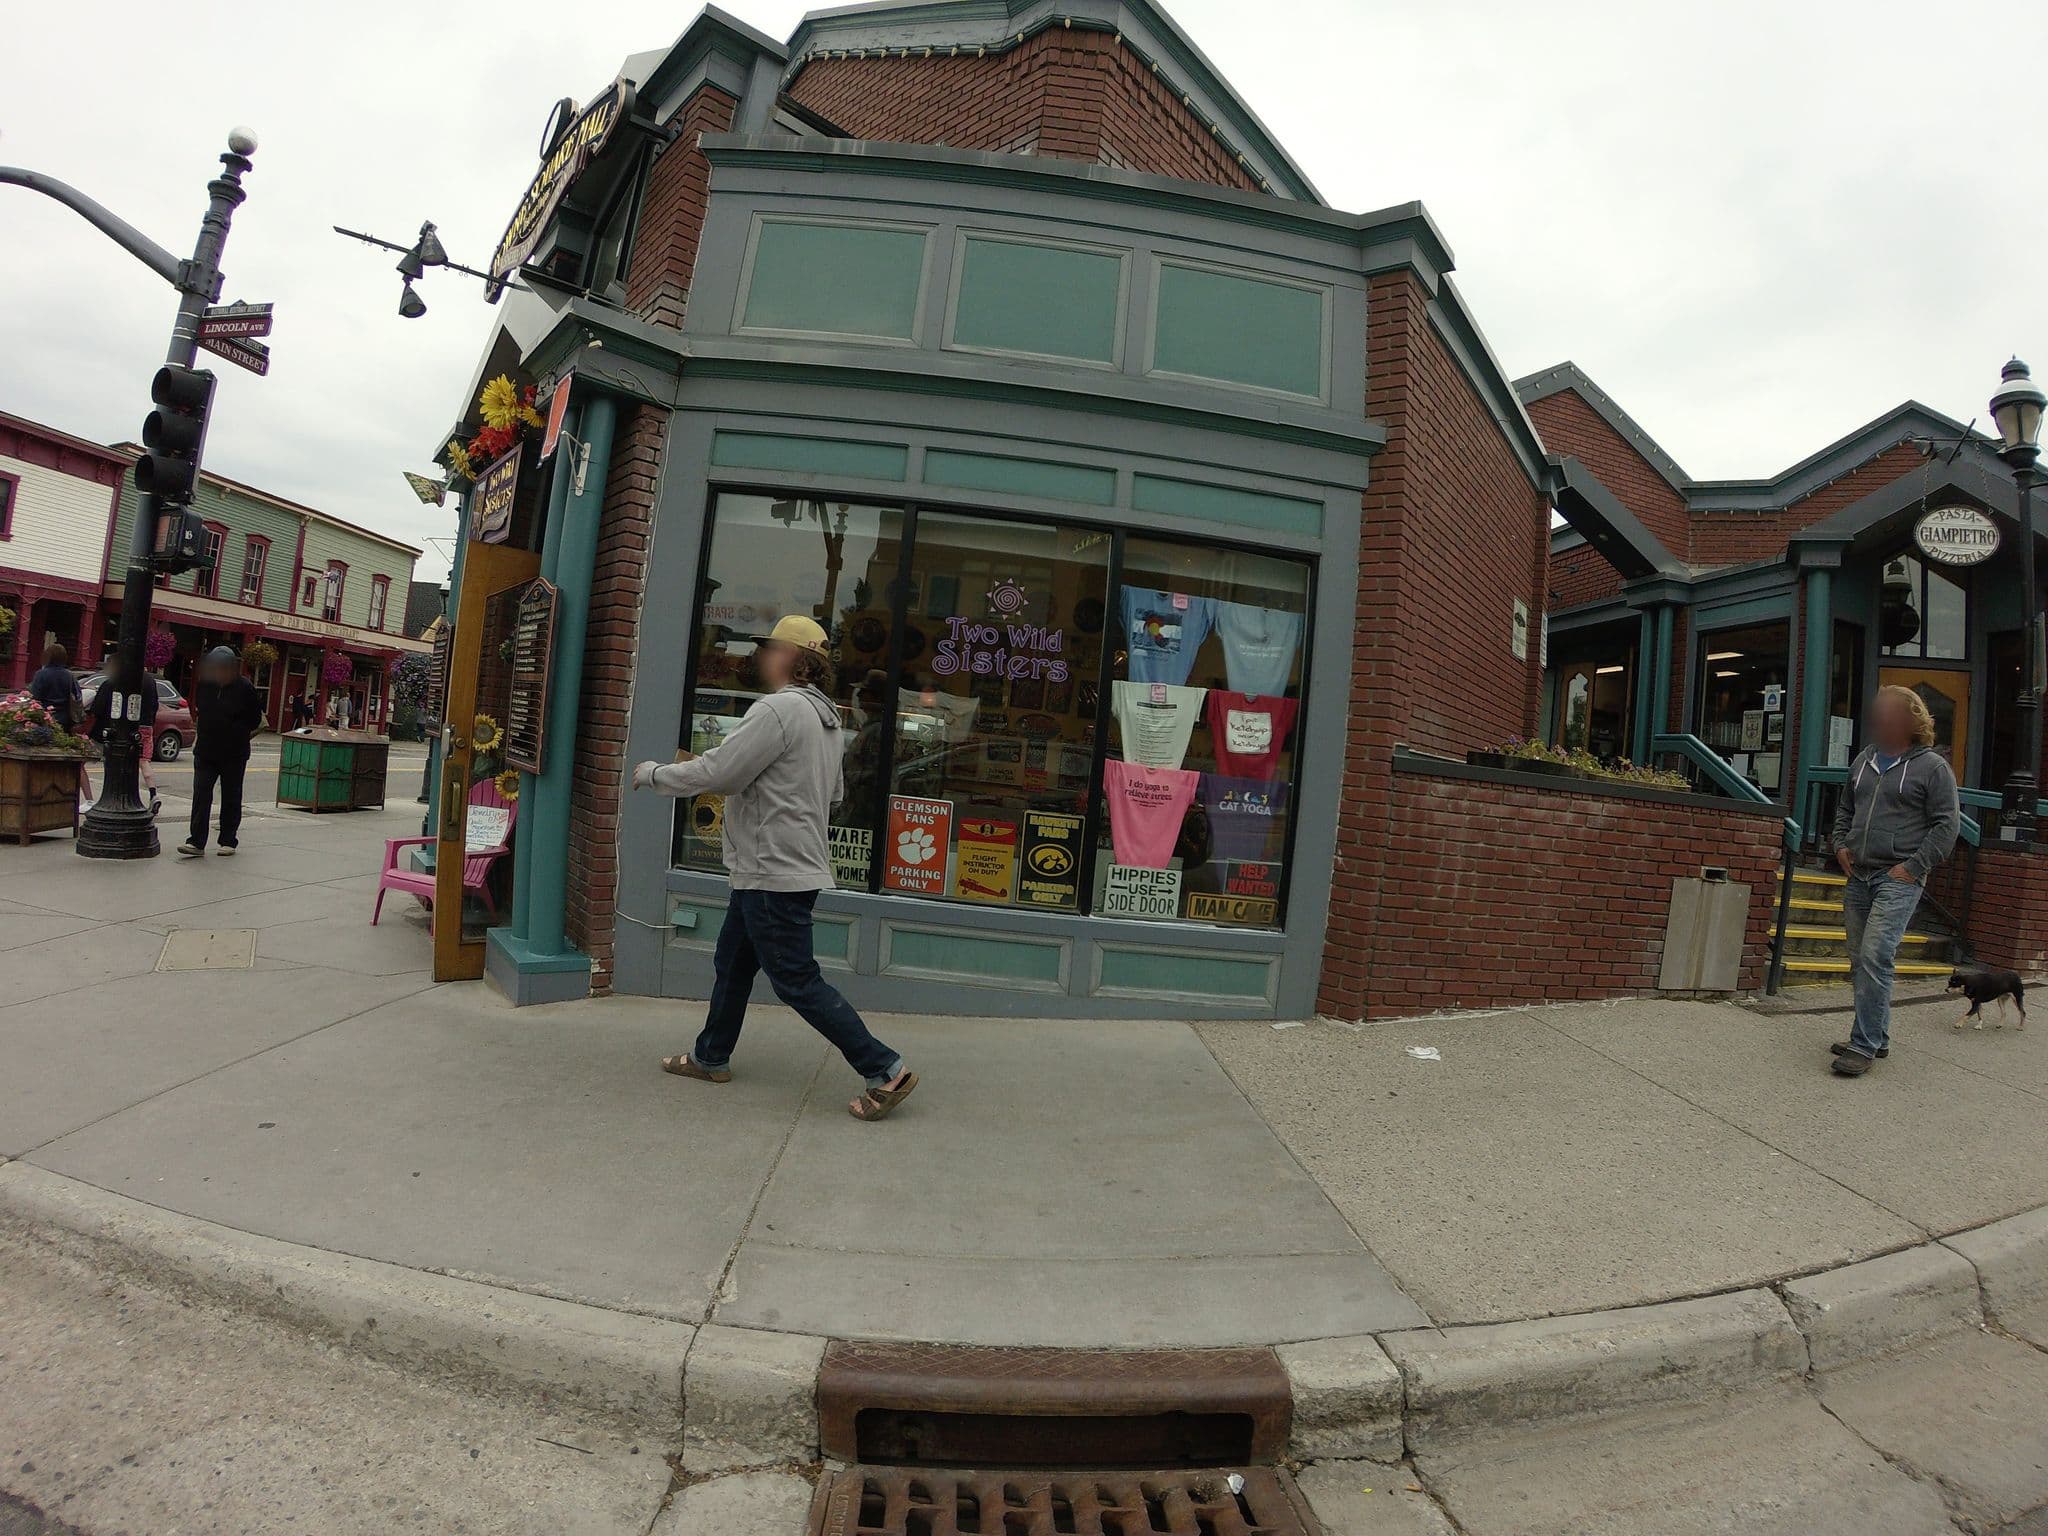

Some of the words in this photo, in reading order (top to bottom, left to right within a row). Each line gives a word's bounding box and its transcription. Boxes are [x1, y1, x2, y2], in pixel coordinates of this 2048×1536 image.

[579, 101, 611, 146] MALL
[204, 322, 249, 333] LINCOLN
[249, 323, 265, 331] AVE
[205, 339, 231, 356] MAIN
[231, 347, 266, 372] STREET
[1938, 508, 1977, 523] PASTA
[1919, 526, 1996, 546] GIAMPIETRO
[1928, 546, 1986, 564] PIZZERIA
[945, 616, 1000, 645] Two
[1006, 623, 1063, 653] Wild
[932, 639, 1069, 683] Sisters
[1124, 788, 1150, 800] relieve
[1128, 779, 1133, 787] I
[1133, 780, 1144, 789] do
[1144, 783, 1161, 793] yoga
[893, 800, 949, 816] CLEMSON
[1219, 800, 1239, 812] CAT
[1242, 802, 1272, 816] YOGA
[905, 813, 935, 825] FANS
[827, 827, 870, 846] WARE
[828, 843, 872, 862] OCKETS
[972, 854, 998, 863] FLIGHT
[890, 865, 942, 880] PARKING
[963, 860, 1006, 871] INSTRUCTOR
[968, 867, 980, 875] ON
[980, 869, 999, 877] DUTY
[1238, 863, 1269, 880] HELP
[899, 877, 929, 890] ONLY
[1111, 867, 1178, 886] HIPPIES
[1128, 883, 1158, 897] USE
[1227, 878, 1277, 896] WANTED
[1107, 893, 1136, 912] SIDE
[1139, 895, 1176, 916] DOOR
[1193, 898, 1229, 918] MAN
